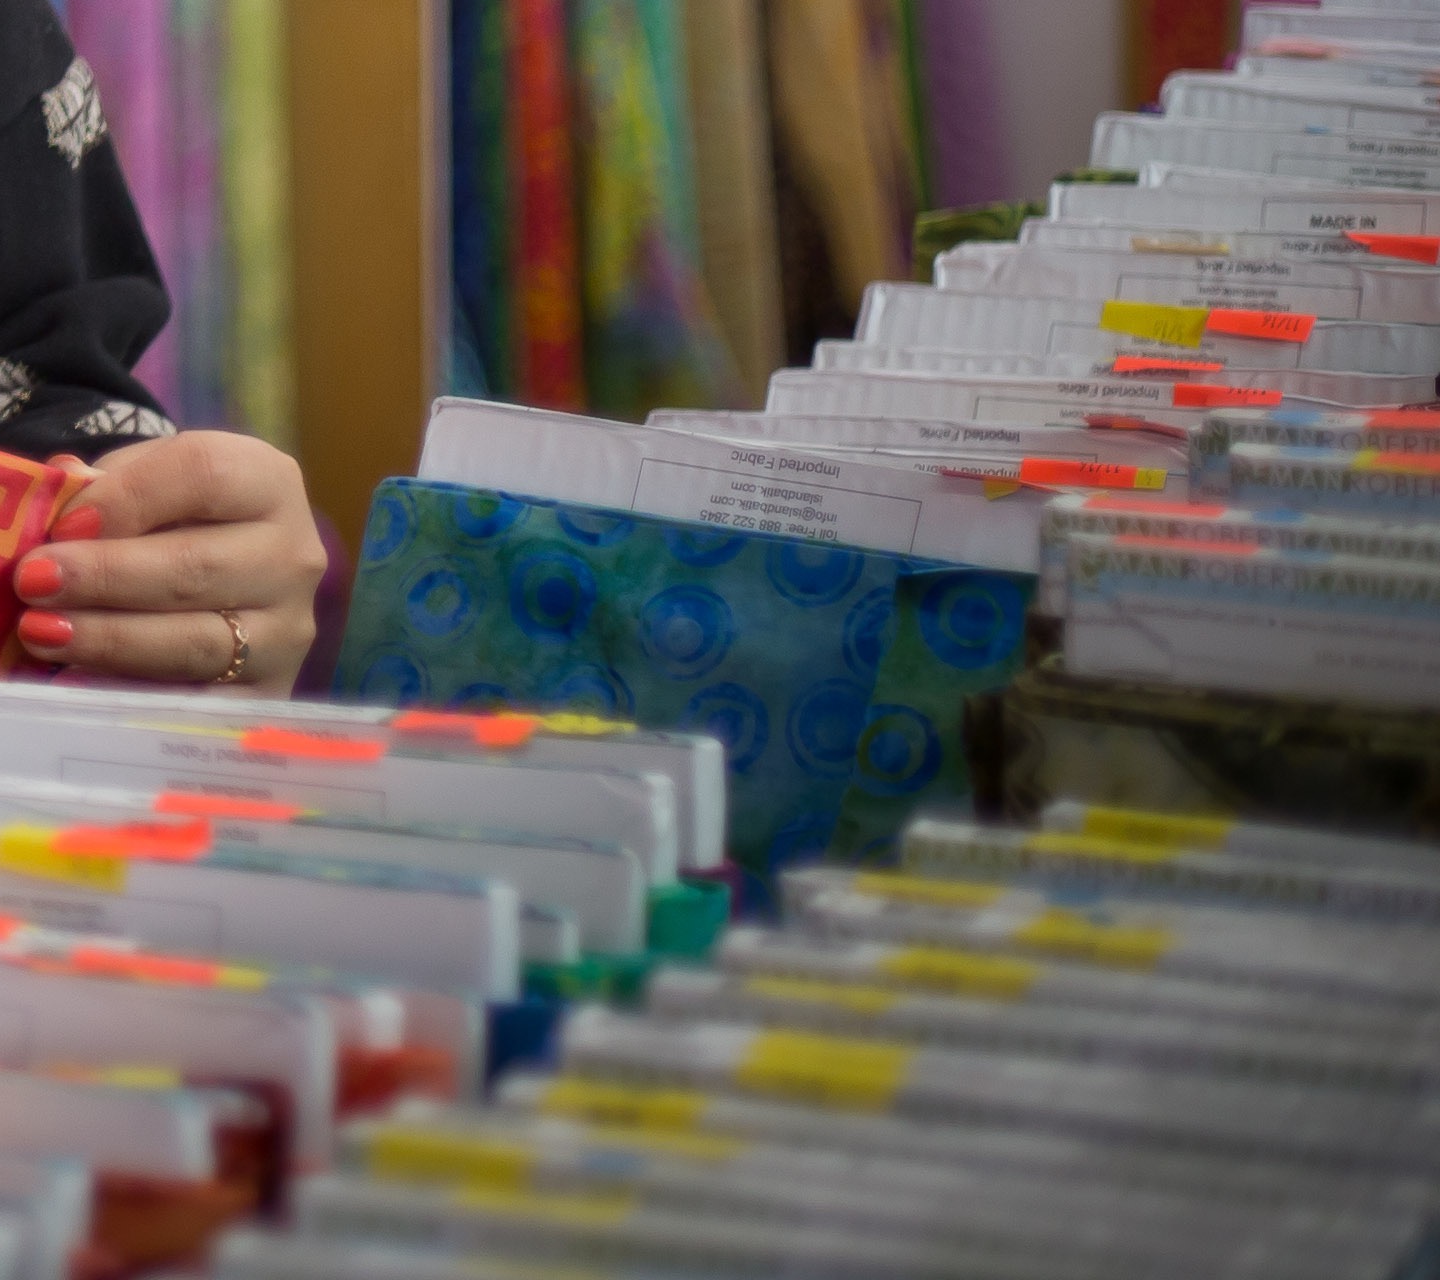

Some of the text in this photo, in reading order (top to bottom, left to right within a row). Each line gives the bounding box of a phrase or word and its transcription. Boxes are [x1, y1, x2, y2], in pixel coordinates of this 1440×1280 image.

[1310, 215, 1378, 229] MADE IN
[1102, 384, 1160, 401] Imported
[919, 426, 1021, 443] Imported Fabric
[731, 450, 840, 479] Imported Fabric
[731, 481, 823, 505] islandbatik.com
[710, 494, 837, 524] info@islandbatik.com
[699, 509, 838, 542] Toll Free: 888 522 2845
